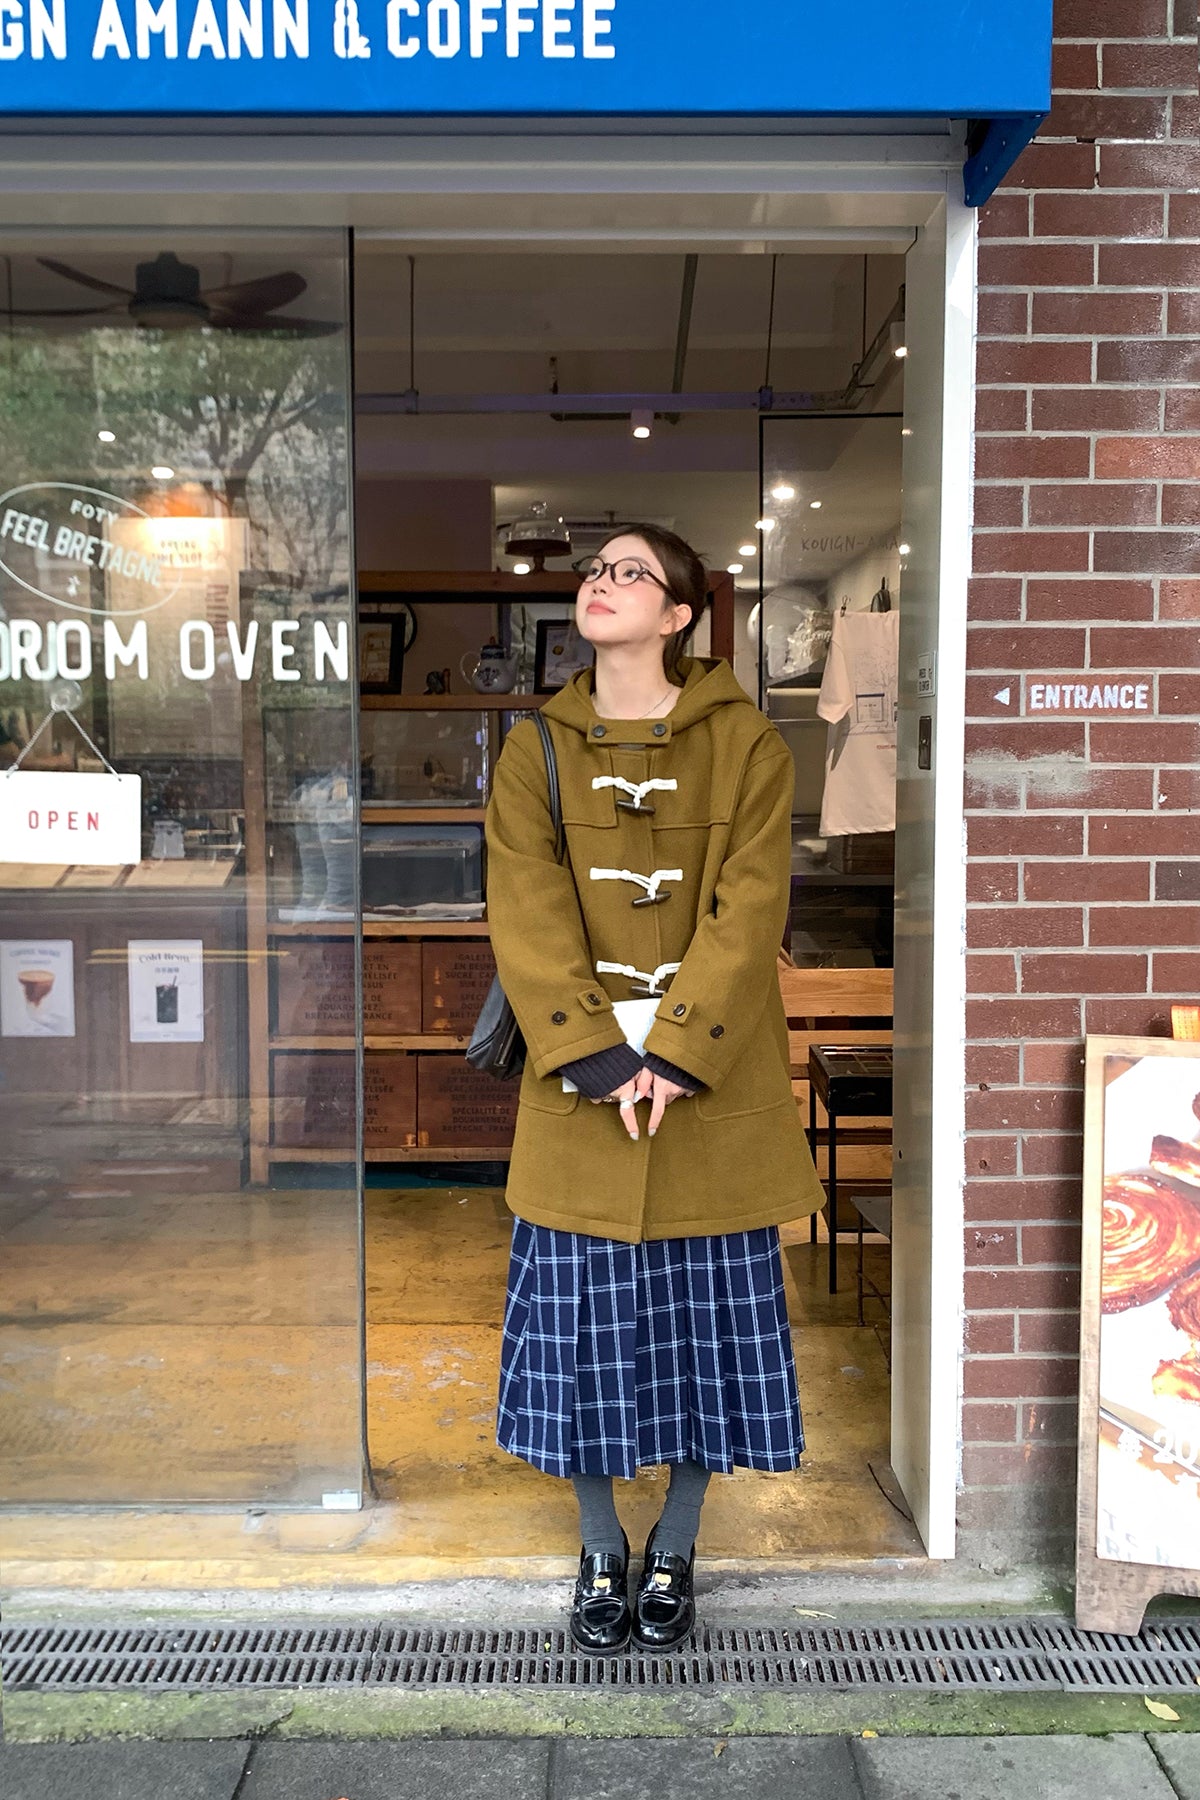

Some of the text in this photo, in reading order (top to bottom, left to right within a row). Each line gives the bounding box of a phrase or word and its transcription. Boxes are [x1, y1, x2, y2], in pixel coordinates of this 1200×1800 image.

[93, 0, 309, 60] AMANN
[333, 0, 371, 60] &
[387, 0, 616, 59] COFFEE
[1, 509, 162, 588] FEEL BRETAGNE
[179, 619, 349, 681] OVEN
[1030, 684, 1149, 709] ENTRANCE
[28, 810, 99, 831] OPEN
